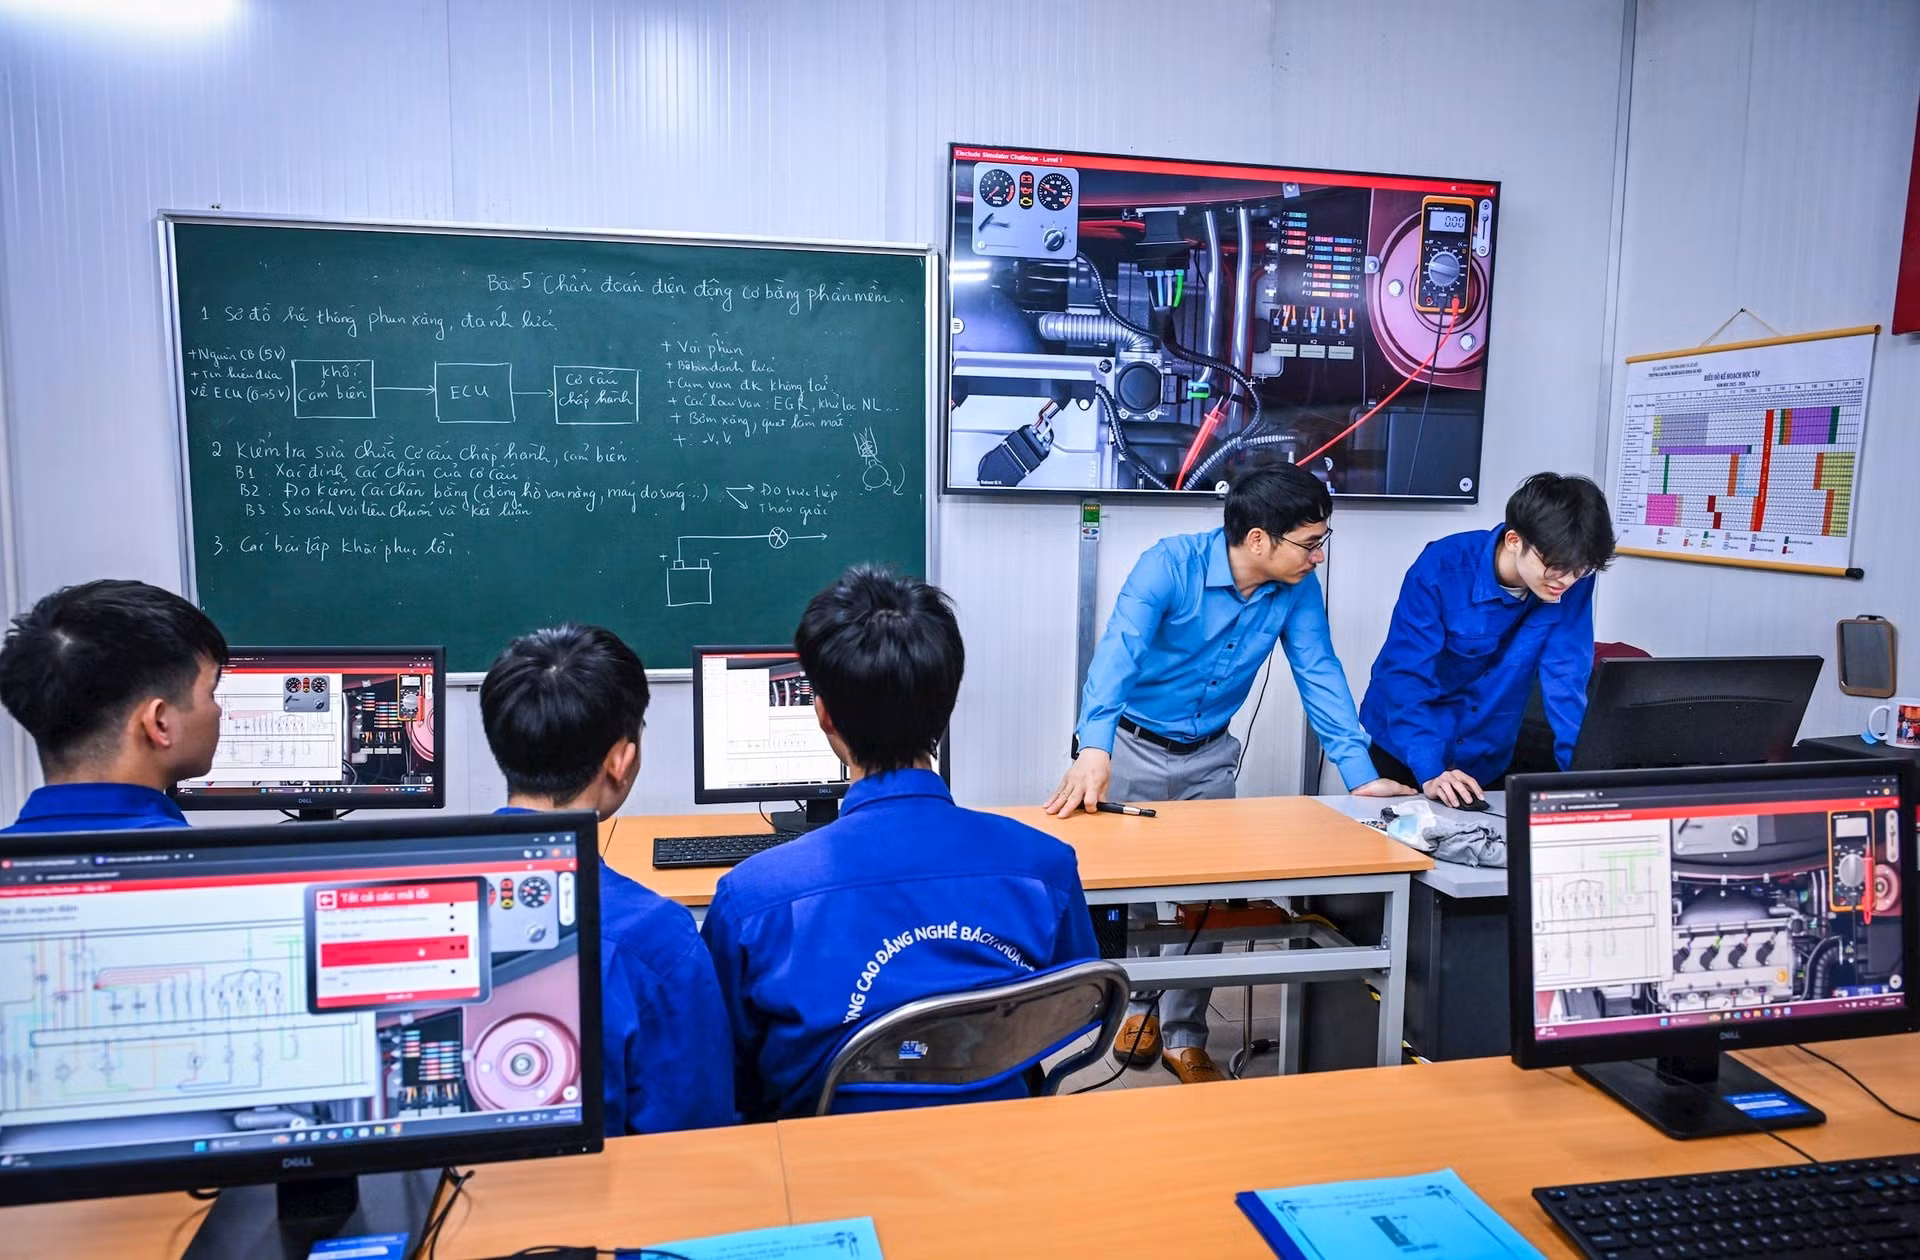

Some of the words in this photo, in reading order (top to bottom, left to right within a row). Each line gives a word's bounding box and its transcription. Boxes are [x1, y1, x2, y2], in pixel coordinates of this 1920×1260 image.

[521, 272, 534, 289] 5
[694, 278, 732, 312] động
[766, 278, 800, 316] bằng
[854, 280, 892, 303] mềm
[368, 306, 406, 332] phun
[240, 349, 255, 360] CB
[336, 380, 368, 400] biến
[450, 384, 490, 400] ECU
[708, 380, 732, 390] van
[214, 388, 242, 400] ECU
[594, 388, 634, 407] hành
[236, 432, 281, 459] Kiểm
[286, 441, 306, 458] tra
[284, 482, 310, 499] Đo
[760, 483, 782, 496] Đo
[282, 501, 301, 517] So
[305, 499, 336, 516] sánh
[856, 960, 880, 992] CAO
[875, 930, 914, 965] ĐẲNG
[960, 926, 998, 946] BÁCH
[1720, 1030, 1741, 1040] DELL
[282, 1156, 314, 1169] DELL
